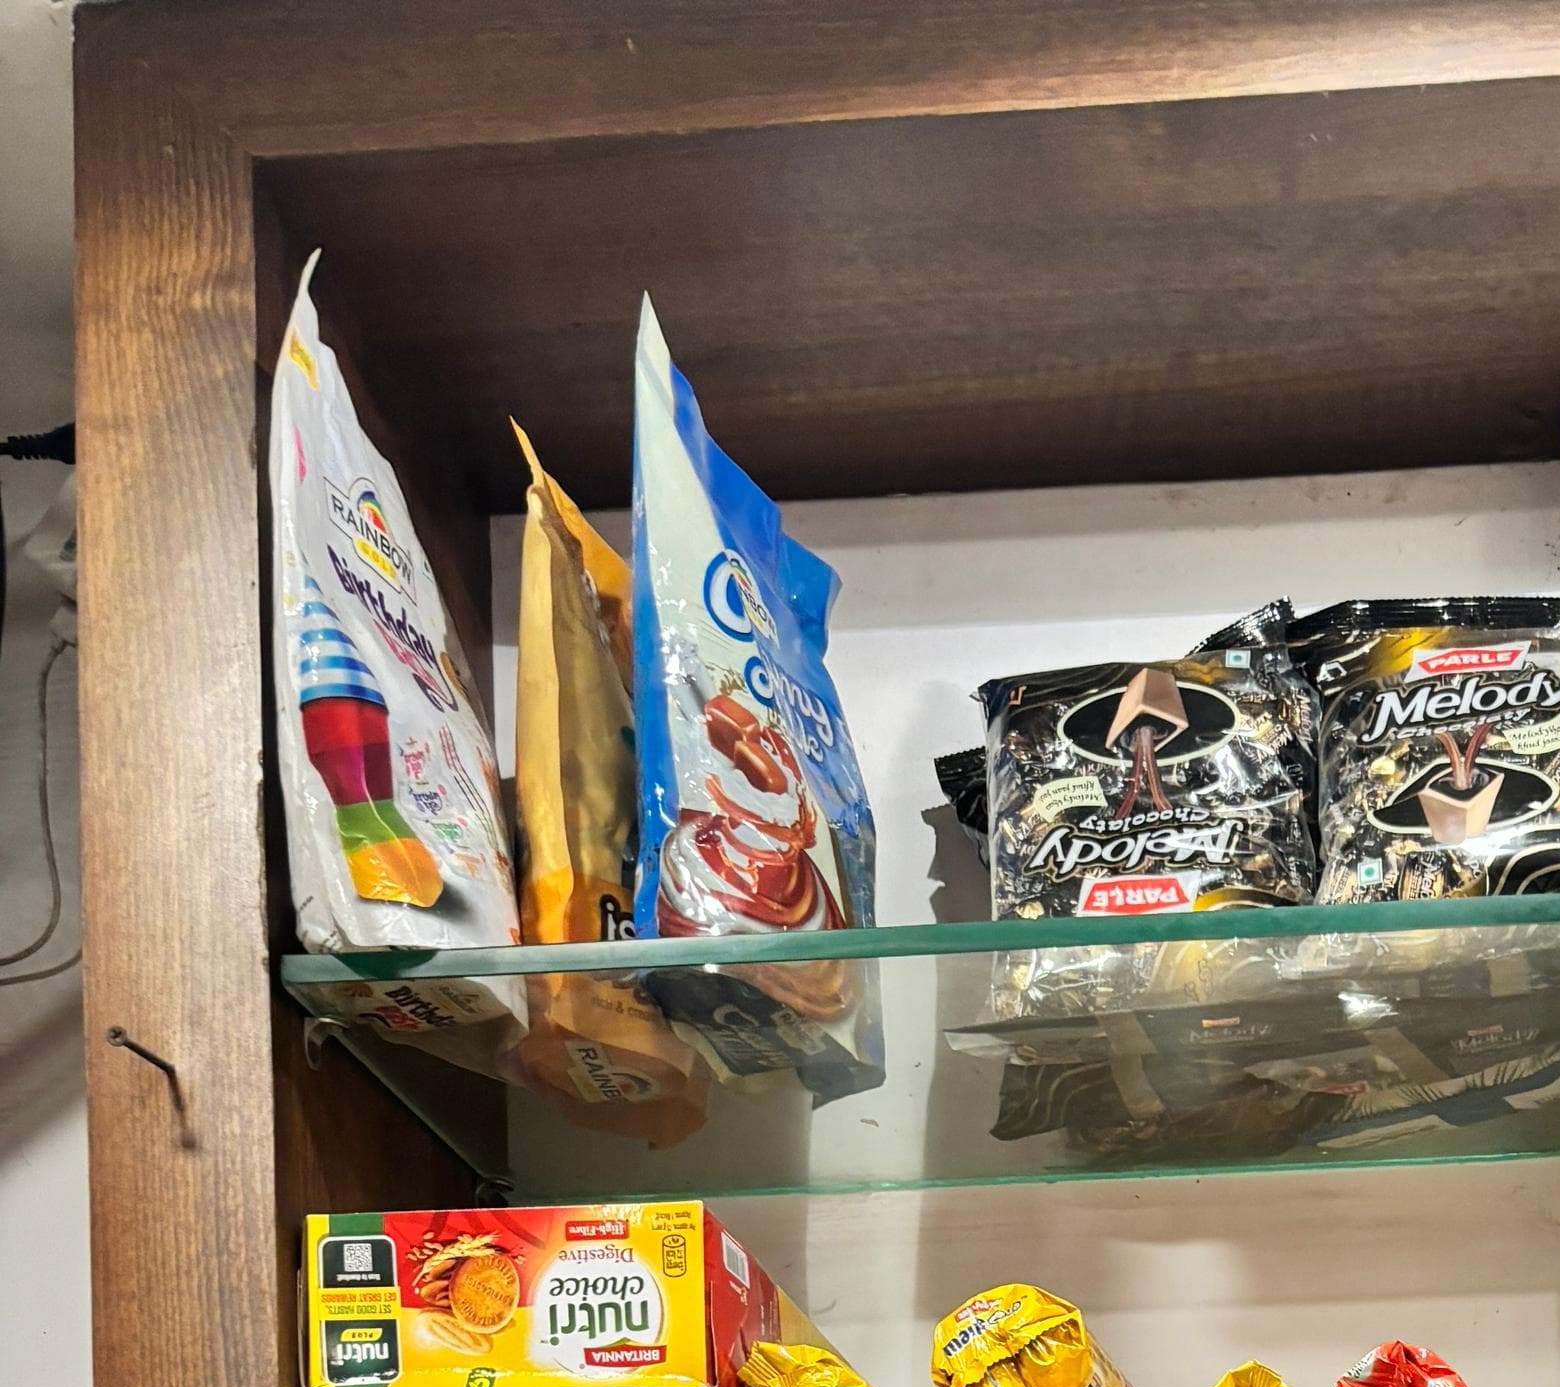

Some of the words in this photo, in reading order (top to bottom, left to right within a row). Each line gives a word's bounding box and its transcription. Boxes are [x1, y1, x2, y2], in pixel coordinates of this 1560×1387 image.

[331, 492, 413, 585] RAINBOW
[1426, 651, 1513, 669] PARLE
[1028, 819, 1244, 875] Melody
[1092, 885, 1180, 908] PARLE
[558, 1248, 635, 1264] Digestive
[549, 1276, 645, 1298] choice
[548, 1299, 650, 1346] nutri
[334, 1342, 390, 1366] nutri
[591, 1350, 660, 1364] BRITANNIA
